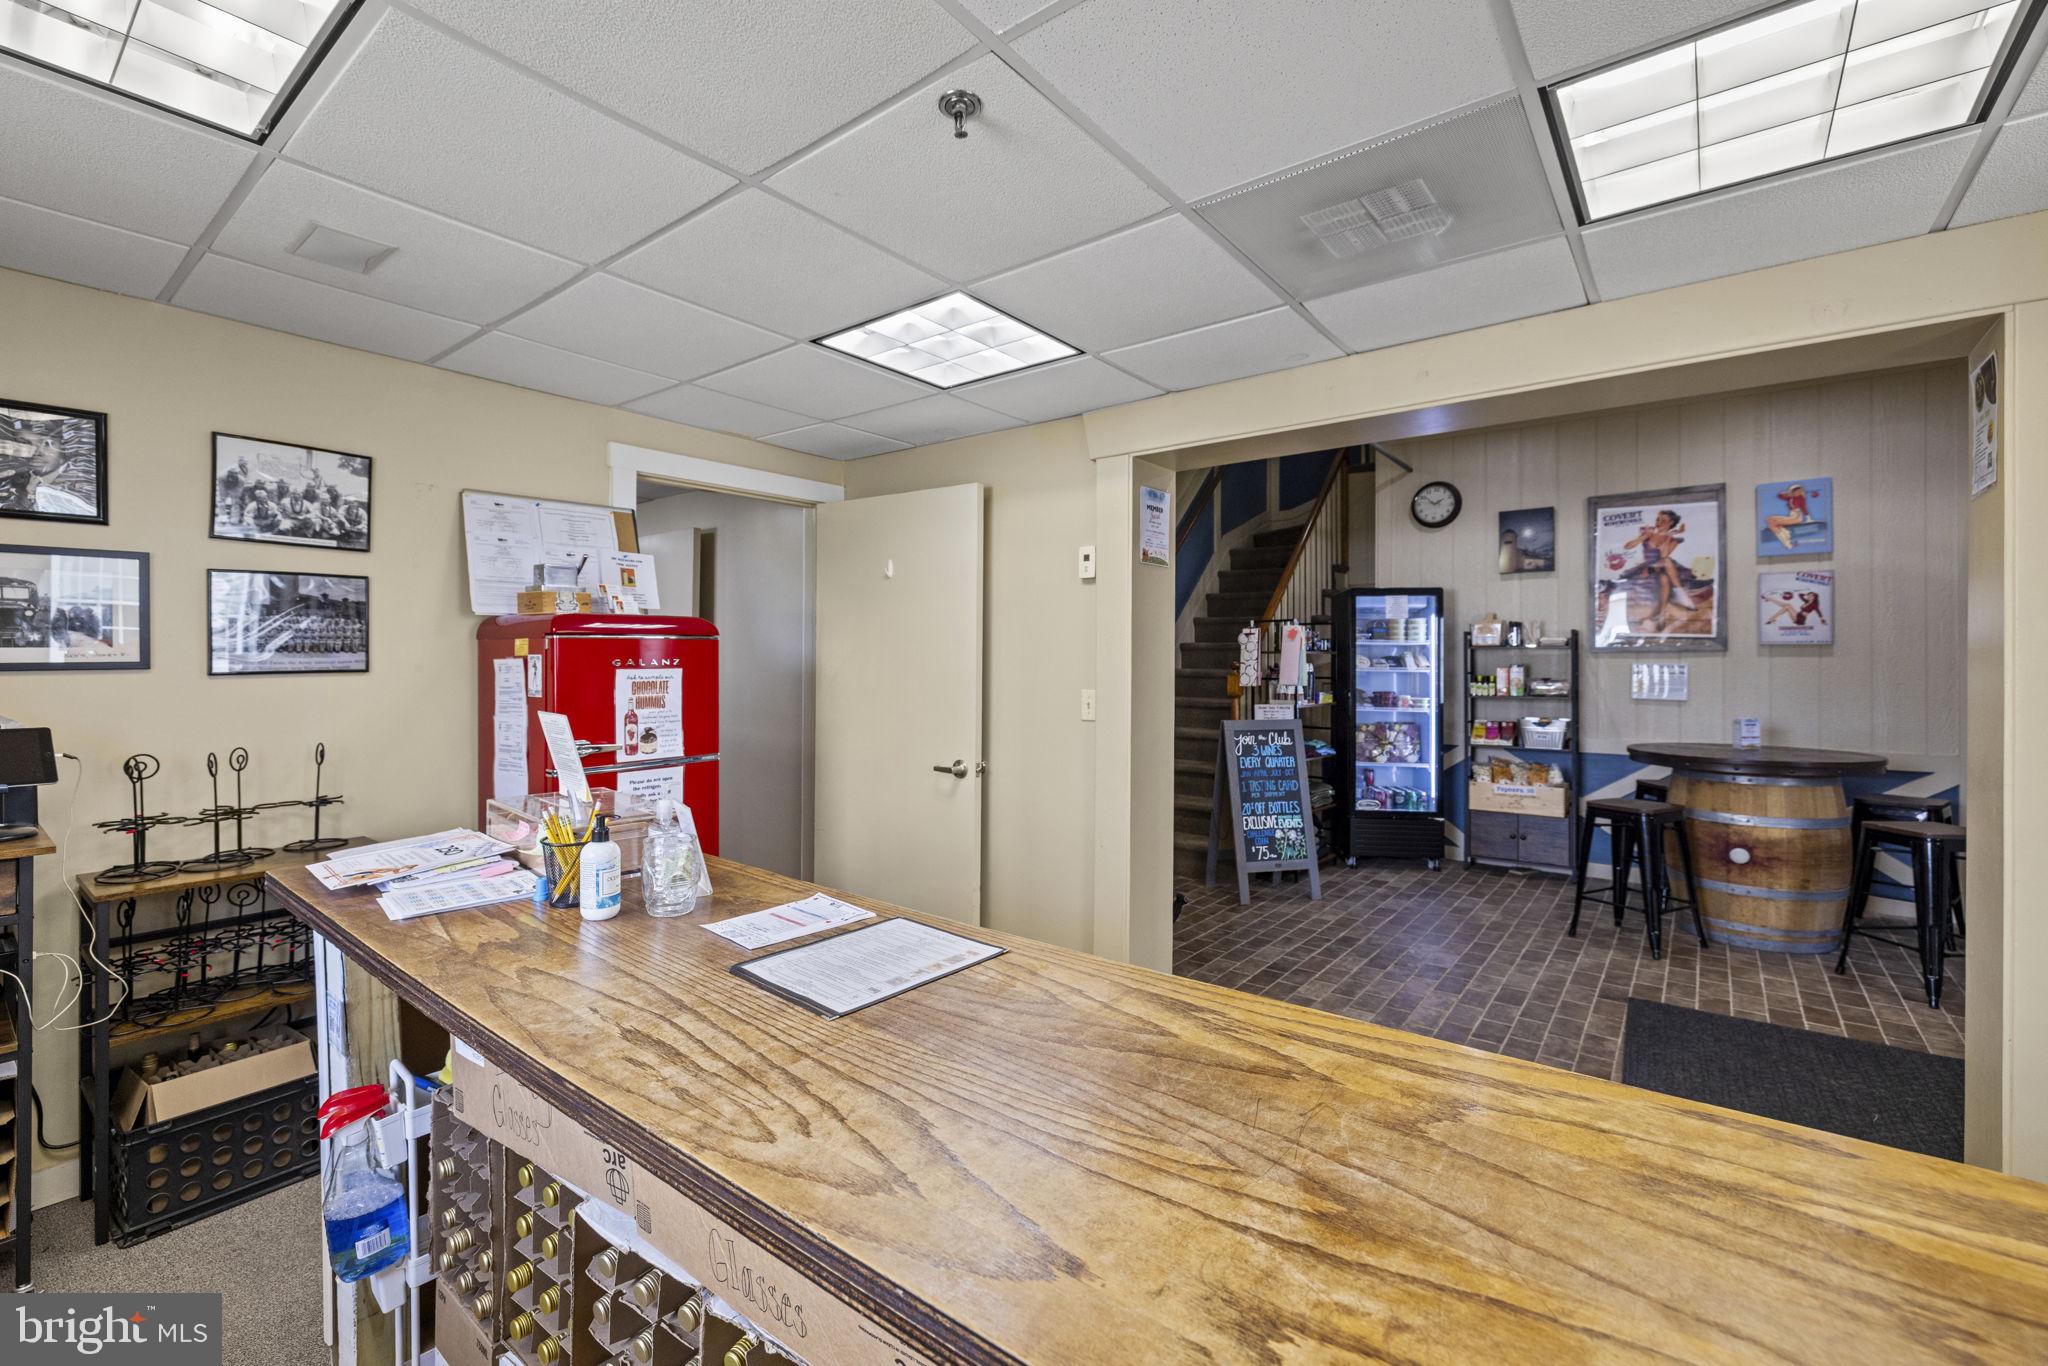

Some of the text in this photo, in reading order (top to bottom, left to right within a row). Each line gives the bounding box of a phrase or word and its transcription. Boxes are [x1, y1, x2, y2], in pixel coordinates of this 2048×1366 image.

[1603, 511, 1643, 522] COVERT
[1796, 571, 1834, 582] COVERT
[612, 658, 681, 667] GALANZ
[631, 680, 669, 696] CHOCOLATE
[635, 695, 666, 709] HUMMUS
[1269, 731, 1293, 746] Club
[1252, 745, 1282, 756] 3 WINES
[1240, 756, 1295, 768] EVERY QUARTER
[1278, 780, 1299, 791] CARD
[1268, 801, 1300, 814] BOTTLES
[1243, 815, 1303, 830] EXCLUSIVE EVENTS
[492, 1084, 542, 1147] Glasses
[603, 1148, 626, 1170] arc
